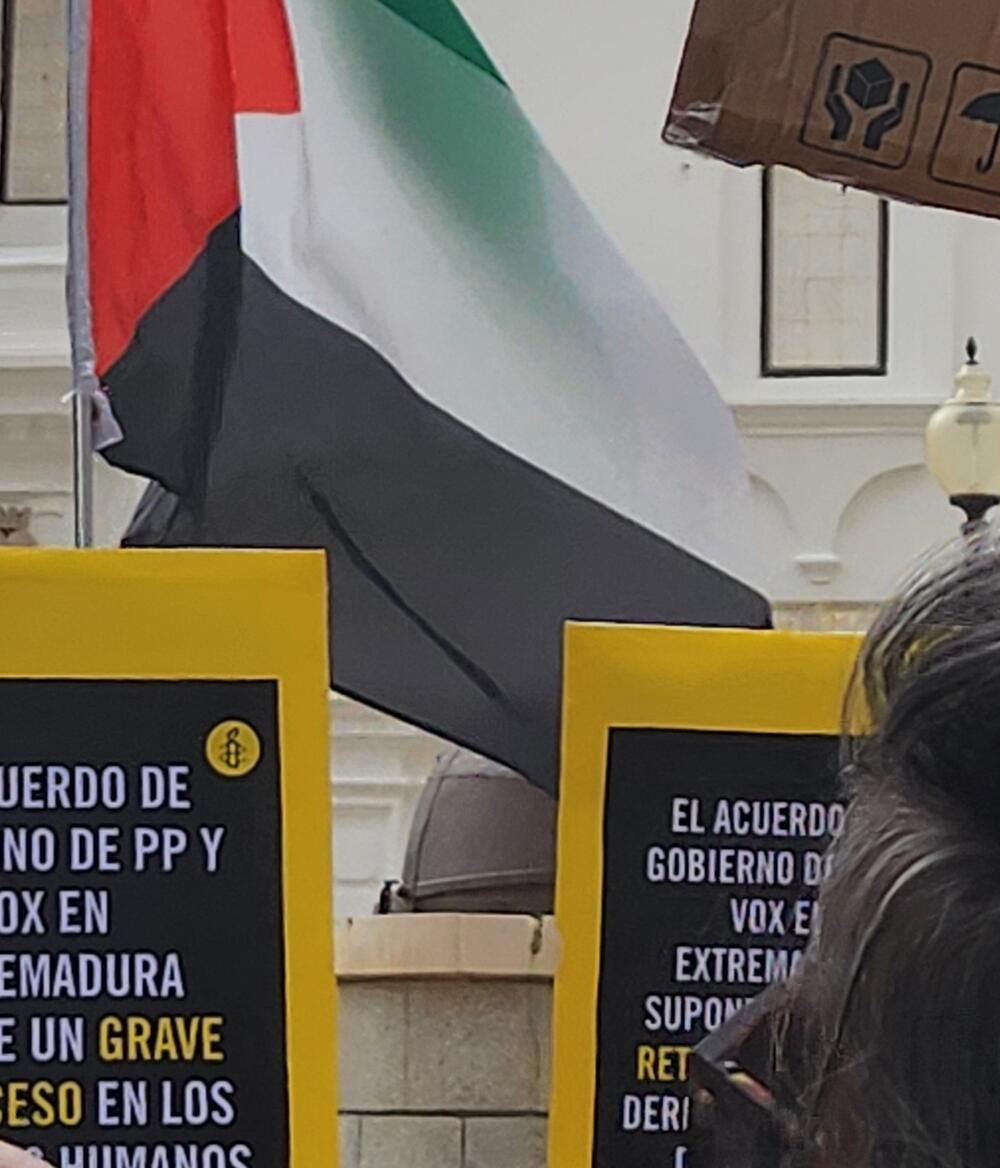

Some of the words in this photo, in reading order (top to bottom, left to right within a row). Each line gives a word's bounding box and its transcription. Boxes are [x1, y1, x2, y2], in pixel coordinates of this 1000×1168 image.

[141, 766, 192, 809] DE
[672, 797, 705, 833] EL
[713, 799, 845, 837] ACUERDO
[3, 827, 55, 872] NO
[70, 828, 121, 871] DE
[134, 827, 188, 872] PP
[200, 827, 225, 872] Y
[647, 846, 795, 886] GOBIERNO
[0, 890, 45, 934] OX
[59, 890, 108, 934] EN
[730, 898, 785, 935] VOX
[0, 953, 185, 998] EMADURA
[31, 1017, 84, 1062] UN
[99, 1016, 224, 1061] GRAVE
[0, 1081, 82, 1127] ESO
[98, 1081, 147, 1126] EN
[162, 1081, 235, 1126] LOS
